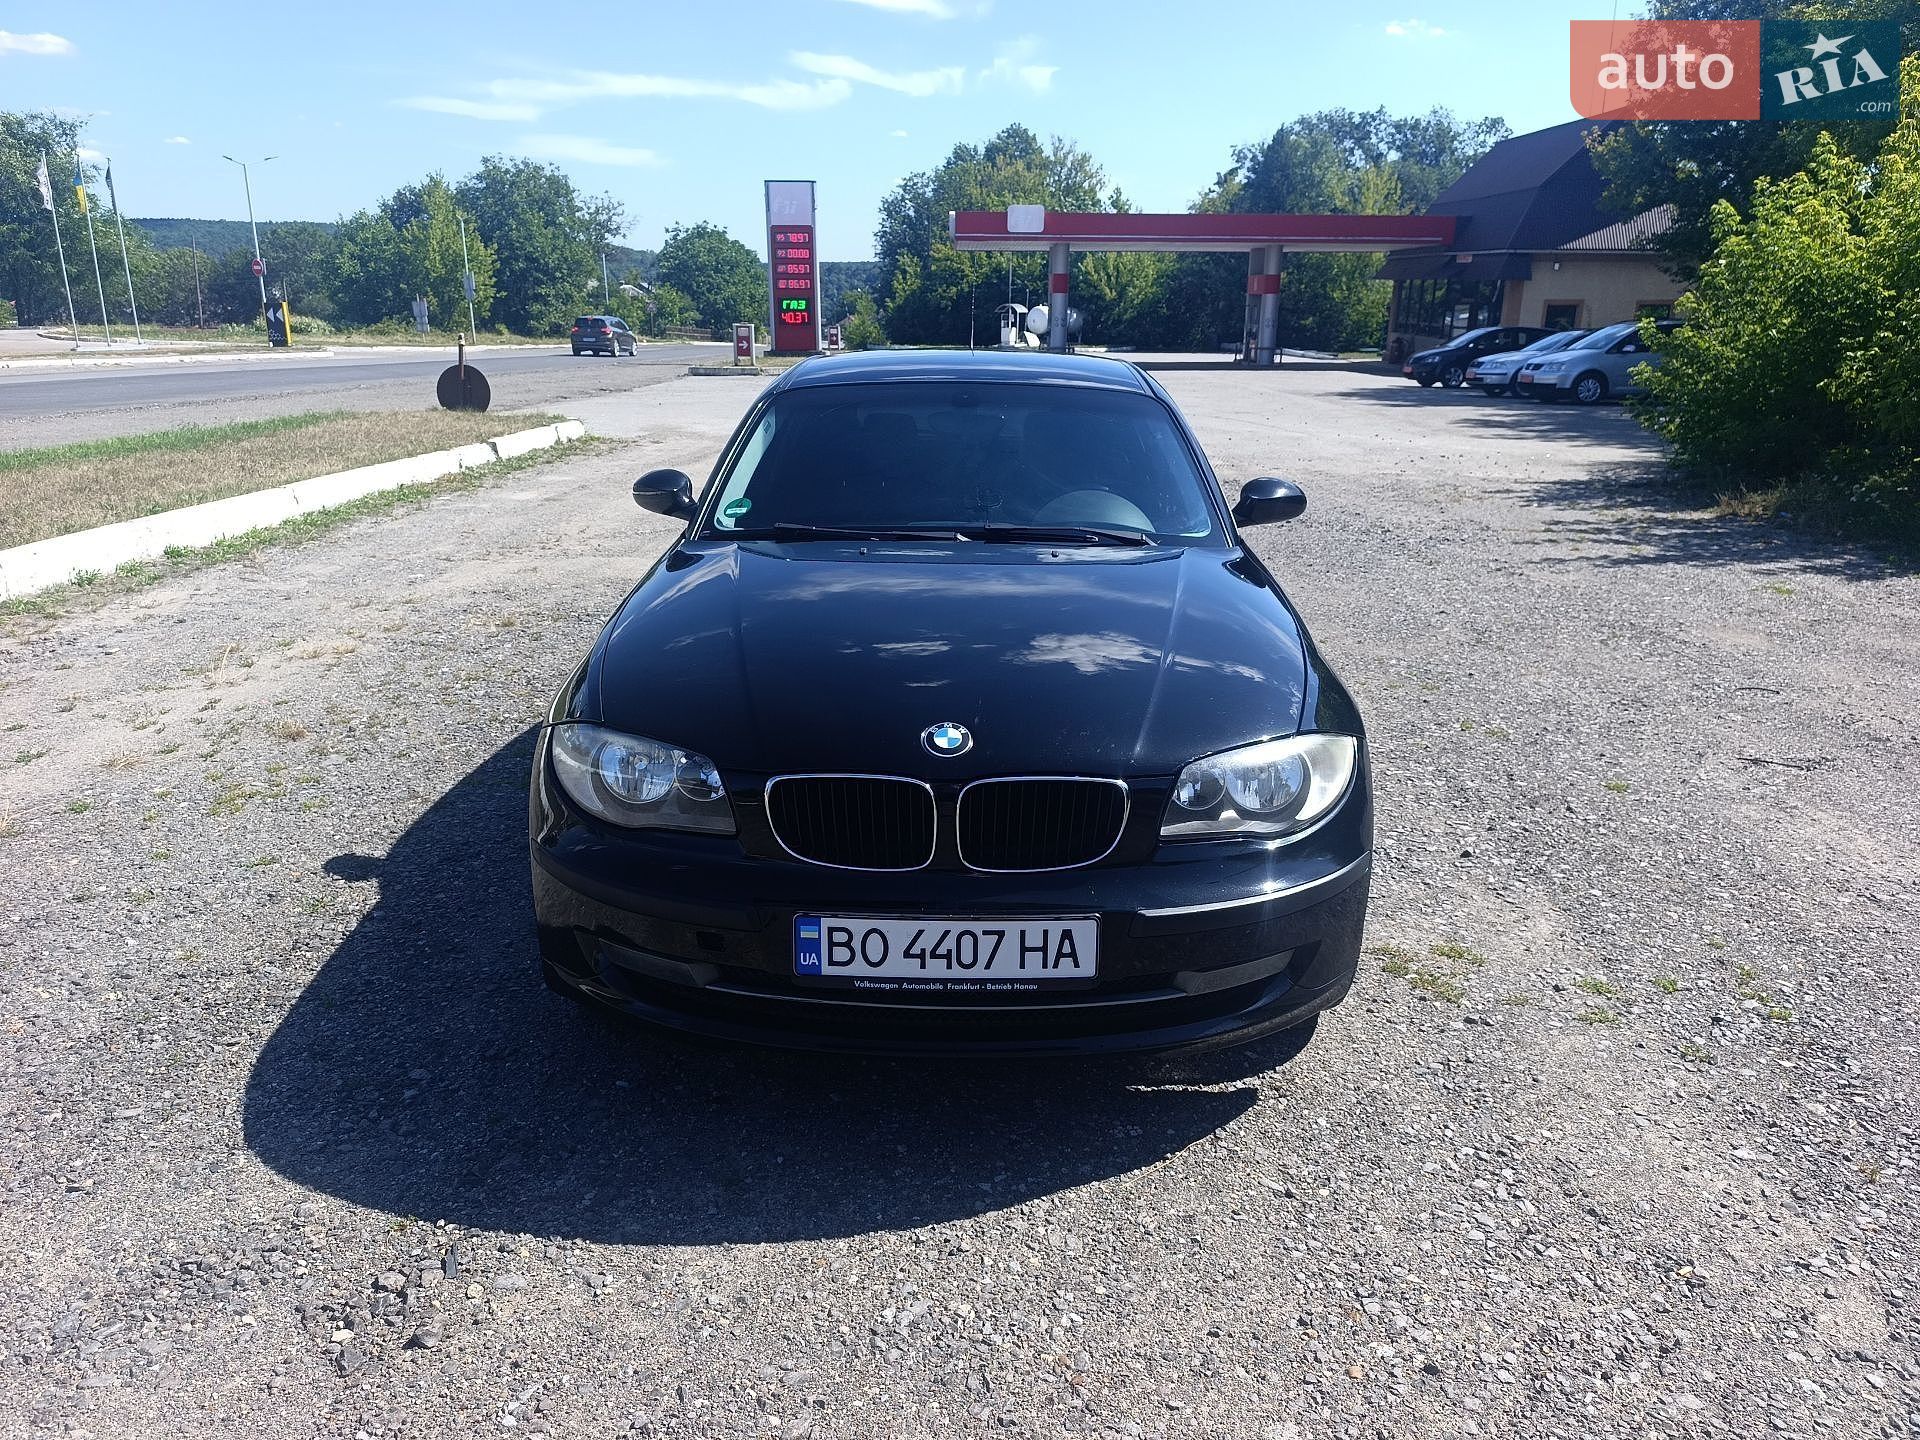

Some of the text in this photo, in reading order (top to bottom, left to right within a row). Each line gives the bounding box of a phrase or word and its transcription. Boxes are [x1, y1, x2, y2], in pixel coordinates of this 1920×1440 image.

[776, 233, 785, 241] 95
[782, 300, 806, 309] ГАЗ
[800, 926, 1081, 970] UA BO 4407 HA
[854, 980, 899, 990] Volkswagen
[902, 981, 944, 990] Automobile
[947, 982, 980, 990] Frankfurt
[986, 982, 1012, 991] Betrieb
[1013, 982, 1038, 991] Hanau
